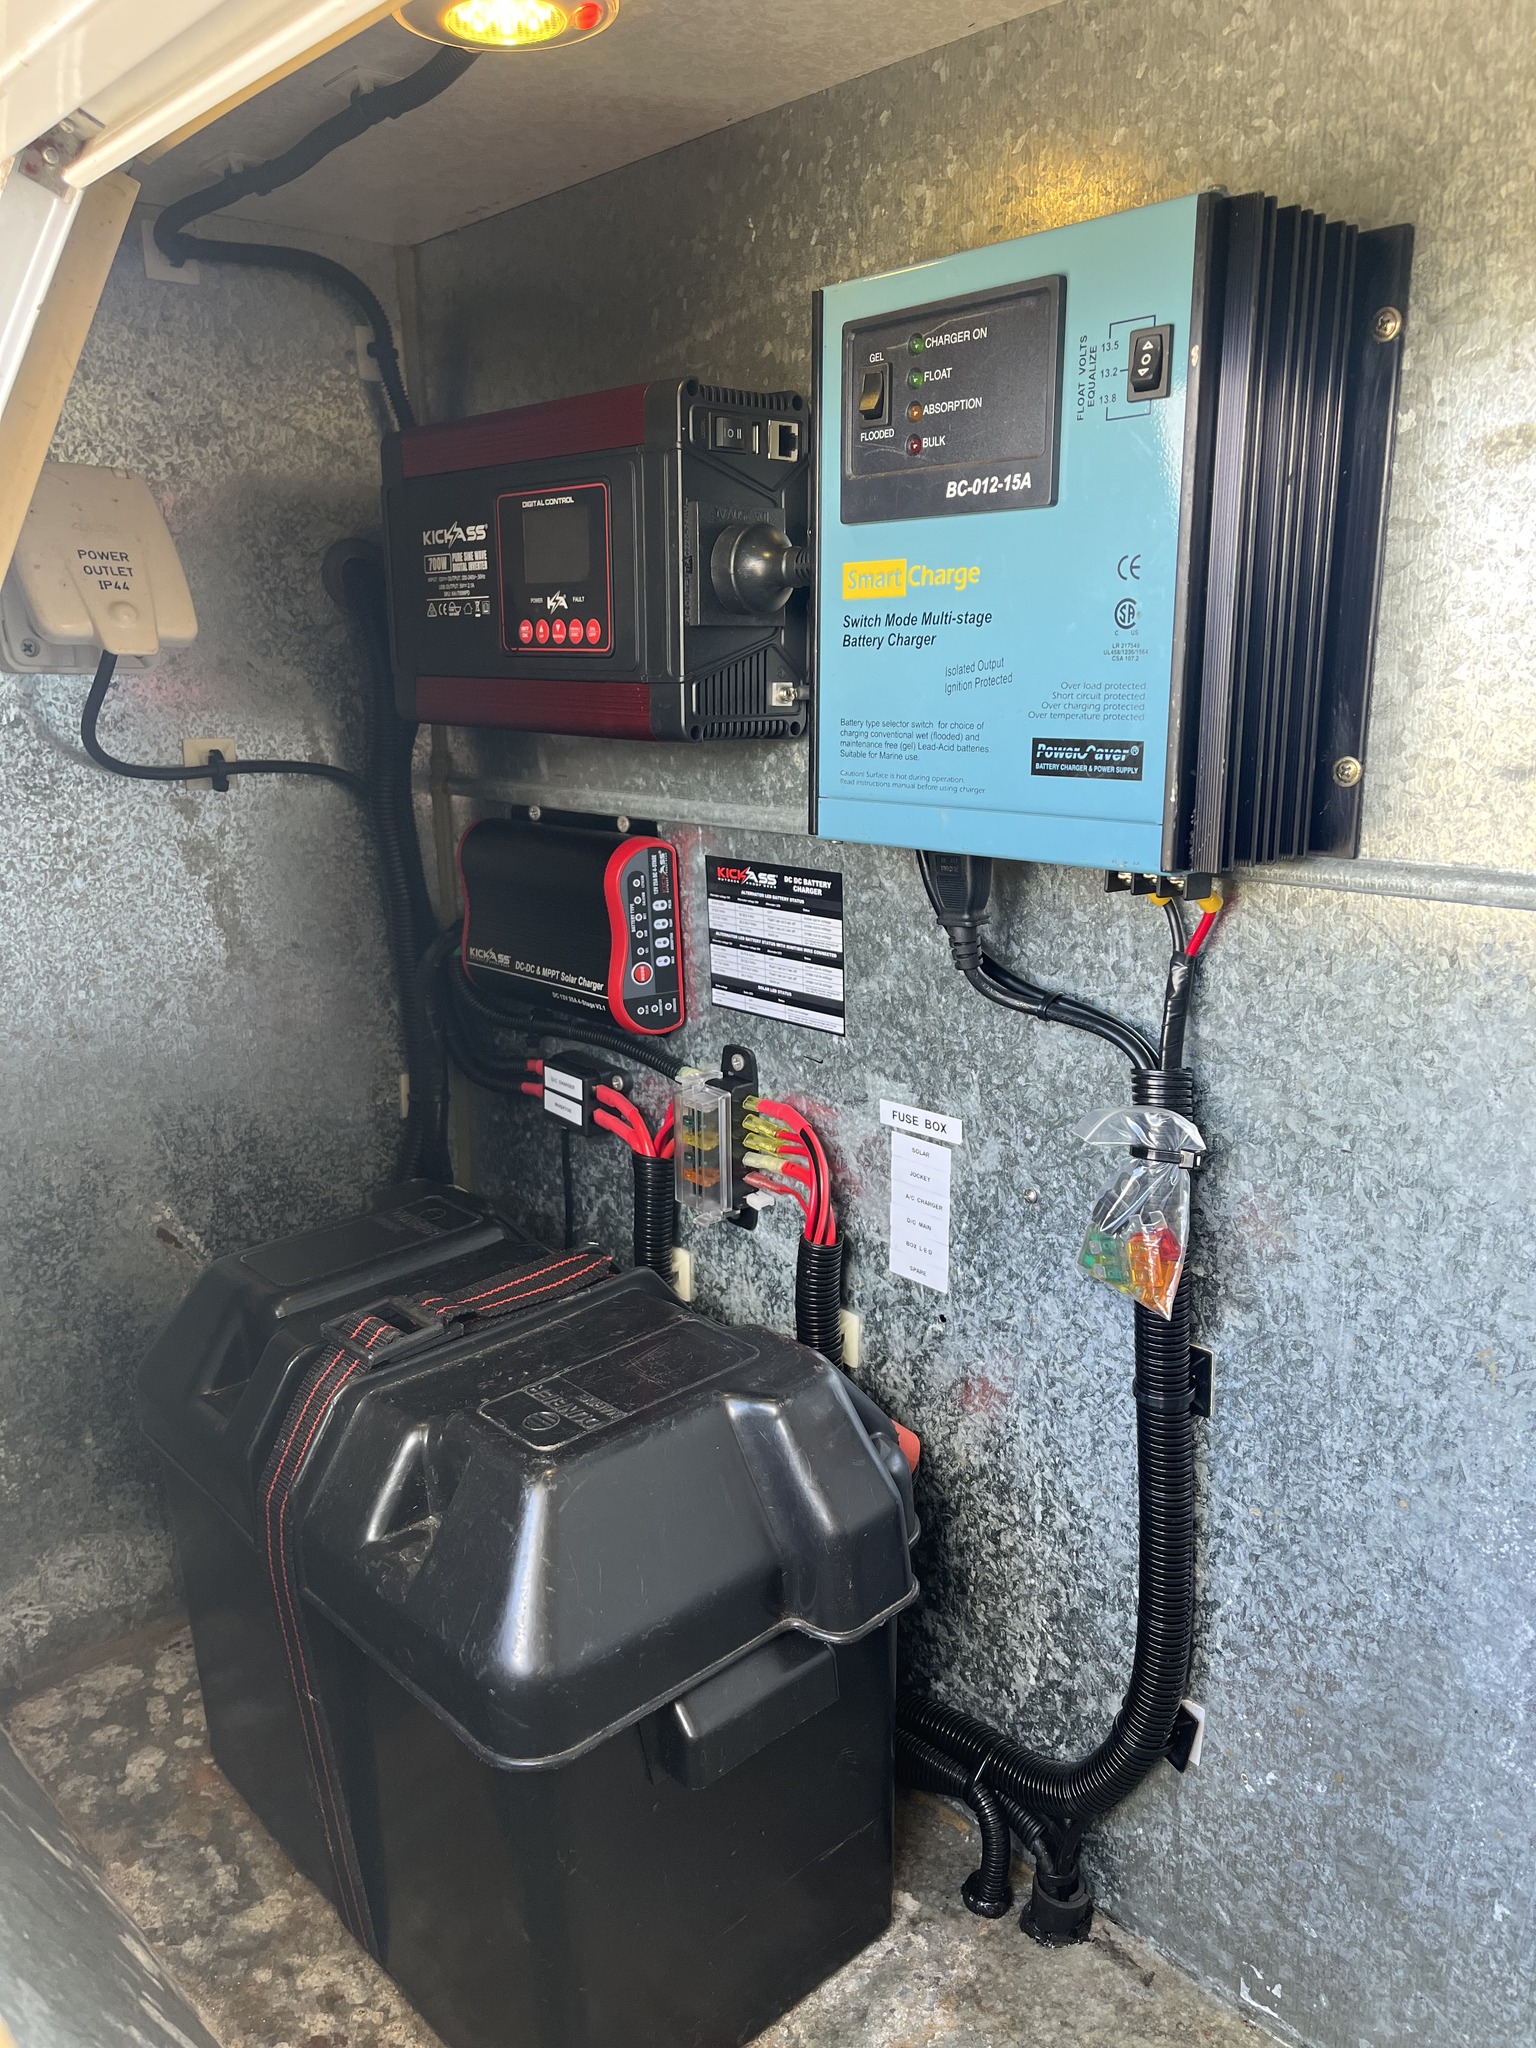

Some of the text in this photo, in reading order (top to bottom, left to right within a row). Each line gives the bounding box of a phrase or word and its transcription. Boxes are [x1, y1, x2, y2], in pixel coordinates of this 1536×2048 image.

[925, 327, 988, 348] CHARGER ON
[1101, 340, 1119, 352] 13.5
[869, 352, 884, 363] GEL
[924, 367, 952, 382] FLOAT
[1076, 334, 1088, 421] FLOAT VOLTS
[1088, 345, 1098, 408] EQUALIZE
[1100, 367, 1118, 378] 13.2
[1099, 394, 1116, 404] 13.8
[922, 397, 982, 416] ABSORPTION
[860, 428, 894, 442] FLOODED
[922, 435, 946, 448] BULK
[946, 472, 1032, 498] BC-012-15A
[522, 496, 574, 508] DIGITAL CONTROL
[422, 521, 488, 548] KICKASS
[77, 549, 130, 562] POWER
[428, 556, 448, 572] 700W
[83, 565, 134, 578] OUTLET
[848, 564, 980, 591] Smart Charge
[98, 580, 130, 590] IP44
[842, 610, 993, 628] Switch Mode Multi-stage
[842, 632, 938, 650] Battery Charger
[945, 657, 1005, 677] Isolated Output
[944, 672, 1013, 696] Ignition Protected
[1060, 682, 1146, 692] Over load protected
[1052, 692, 1146, 702] Short circuit protected
[1041, 702, 1145, 712] Over charging protected
[1028, 710, 1144, 722] Over temperature protected
[840, 718, 984, 730] Battery type selector switch for choice of
[840, 730, 869, 739] charging
[870, 730, 914, 740] conventional
[930, 732, 964, 742] (flooded)
[964, 734, 980, 742] and
[840, 740, 883, 749] maintenance
[884, 740, 898, 749] free
[900, 742, 916, 752] (gel)
[918, 742, 955, 752] Lead-Acid
[840, 750, 867, 758] Suitable
[868, 750, 878, 759] for
[878, 752, 904, 760] Marine
[1036, 762, 1060, 770] BATTERY
[1060, 764, 1087, 772] CHARGER
[840, 770, 865, 778] Caution!
[866, 771, 888, 779] Surface
[908, 774, 930, 782] during
[856, 780, 891, 788] instructions
[892, 782, 916, 790] manual
[916, 782, 938, 791] before
[940, 784, 958, 793] using
[716, 866, 778, 886] KICKASS
[793, 876, 802, 884] DC
[804, 878, 832, 888] BATTERY
[792, 885, 822, 896] CHARGER
[814, 949, 838, 958] CONNECTED
[515, 960, 536, 974] DC-DC
[542, 967, 560, 980] MPPT
[560, 972, 578, 984] Solar
[578, 976, 605, 991] Charger
[892, 1110, 948, 1134] FUSE BOX
[912, 1148, 930, 1158] SOLAR
[910, 1172, 931, 1183] JOCKEY
[916, 1197, 944, 1211] CHARGER
[918, 1222, 932, 1232] MAIN
[906, 1240, 918, 1250] BOX
[910, 1265, 927, 1276] SPARE
